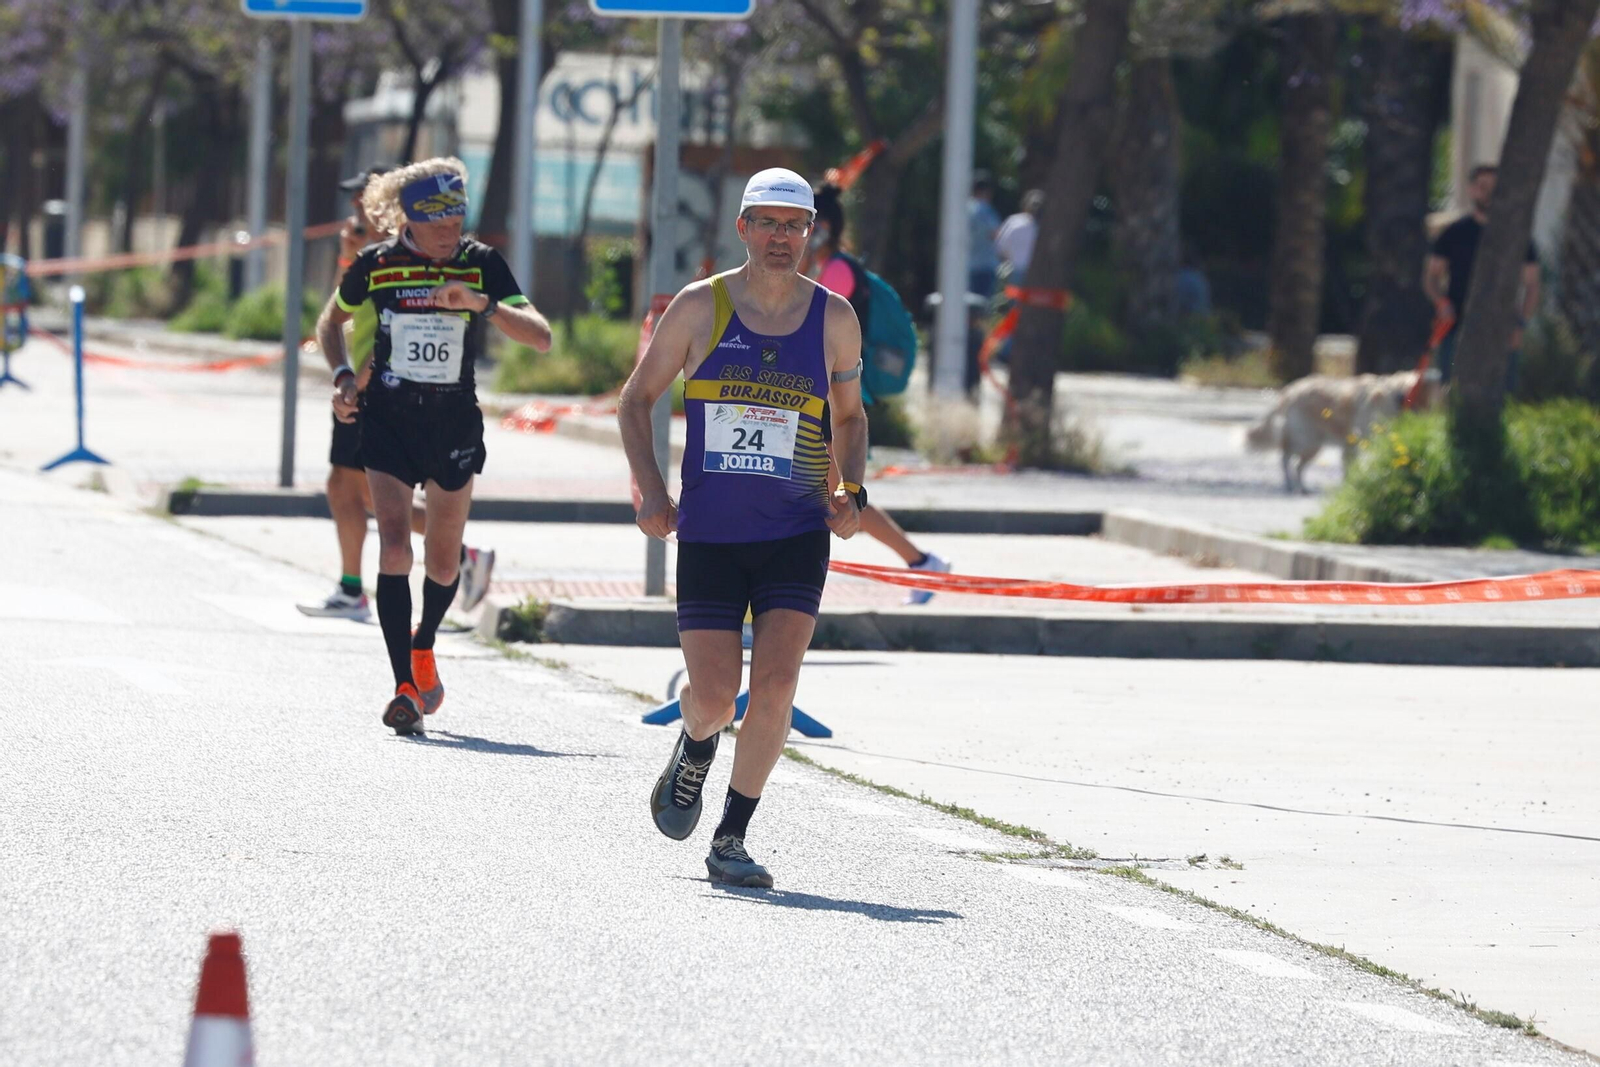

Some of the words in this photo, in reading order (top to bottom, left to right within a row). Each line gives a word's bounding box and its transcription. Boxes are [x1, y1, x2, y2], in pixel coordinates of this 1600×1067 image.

[396, 288, 430, 299] LINCO
[407, 341, 449, 363] 306
[718, 341, 751, 350] MERCURY
[720, 364, 753, 380] ELS
[757, 369, 814, 394] SITGES
[719, 384, 811, 409] BURJASSOT
[731, 427, 765, 452] 24
